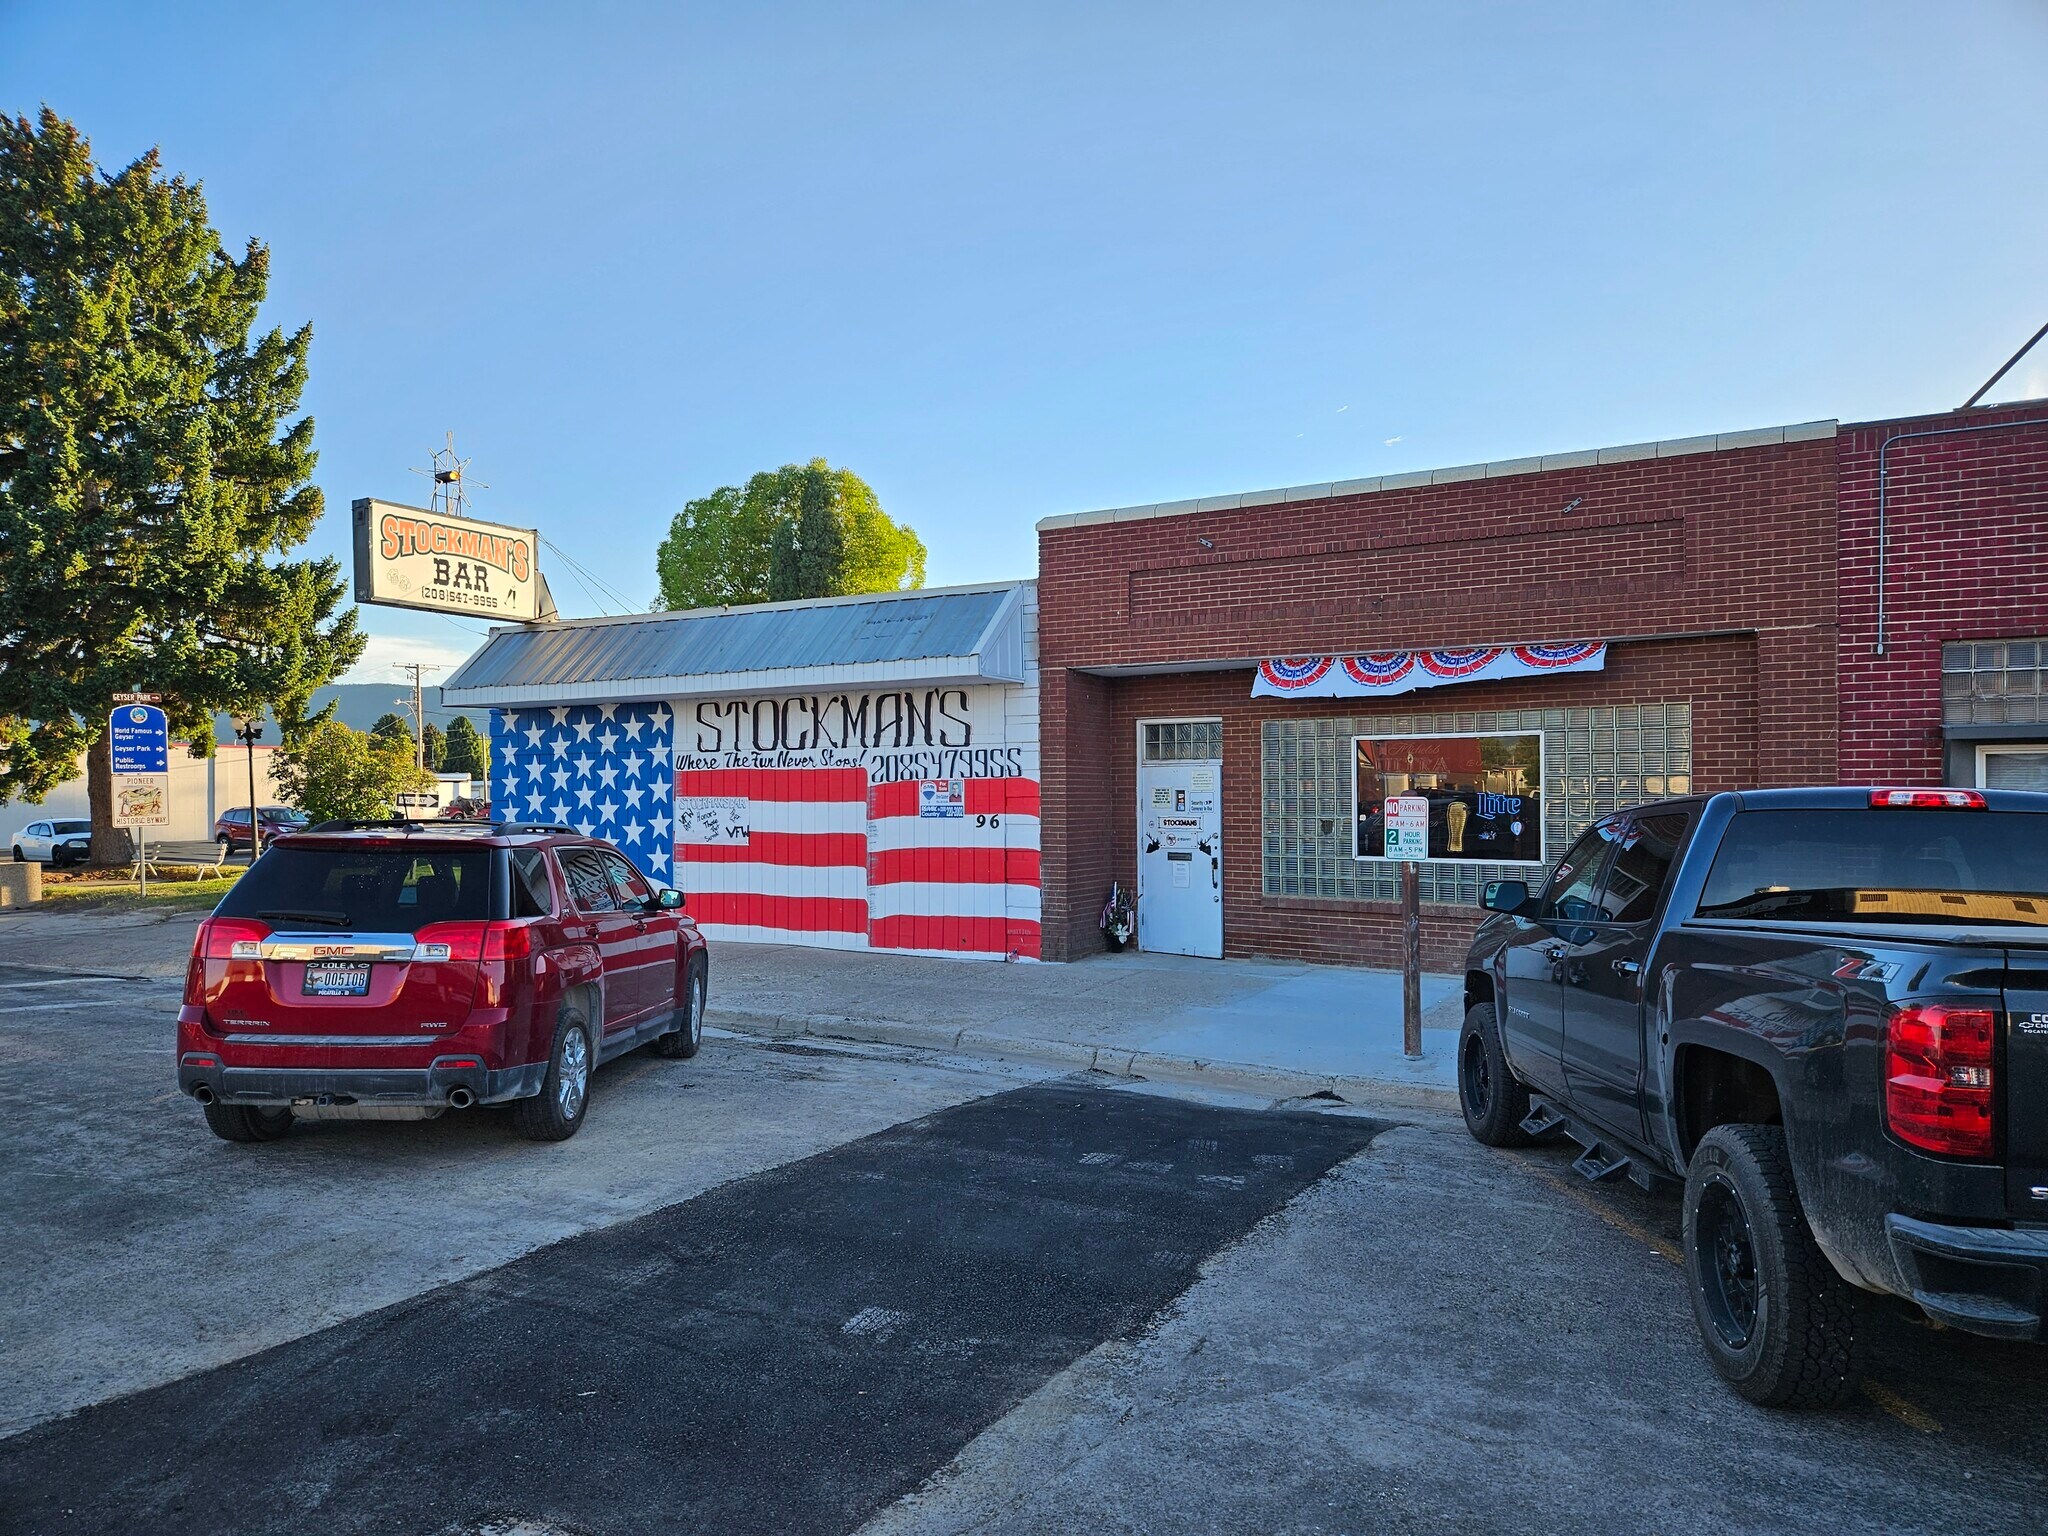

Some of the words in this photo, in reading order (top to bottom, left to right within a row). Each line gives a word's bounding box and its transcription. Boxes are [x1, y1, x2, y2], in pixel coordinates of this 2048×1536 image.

[381, 514, 529, 583] STOCKMAN'S
[433, 558, 489, 593] BAR
[421, 585, 498, 608] (208)547-9955
[696, 688, 971, 753] STOCKMAN'S
[676, 754, 720, 770] Where
[724, 751, 750, 768] The
[751, 751, 776, 768] Fun
[777, 751, 818, 768] Never
[820, 749, 867, 768] Stops!
[1387, 802, 1398, 814] NO
[1476, 792, 1521, 819] Lite
[725, 825, 750, 838] VFW
[1388, 831, 1397, 843] 2
[313, 946, 355, 956] GMC
[1832, 958, 1902, 979] Z71
